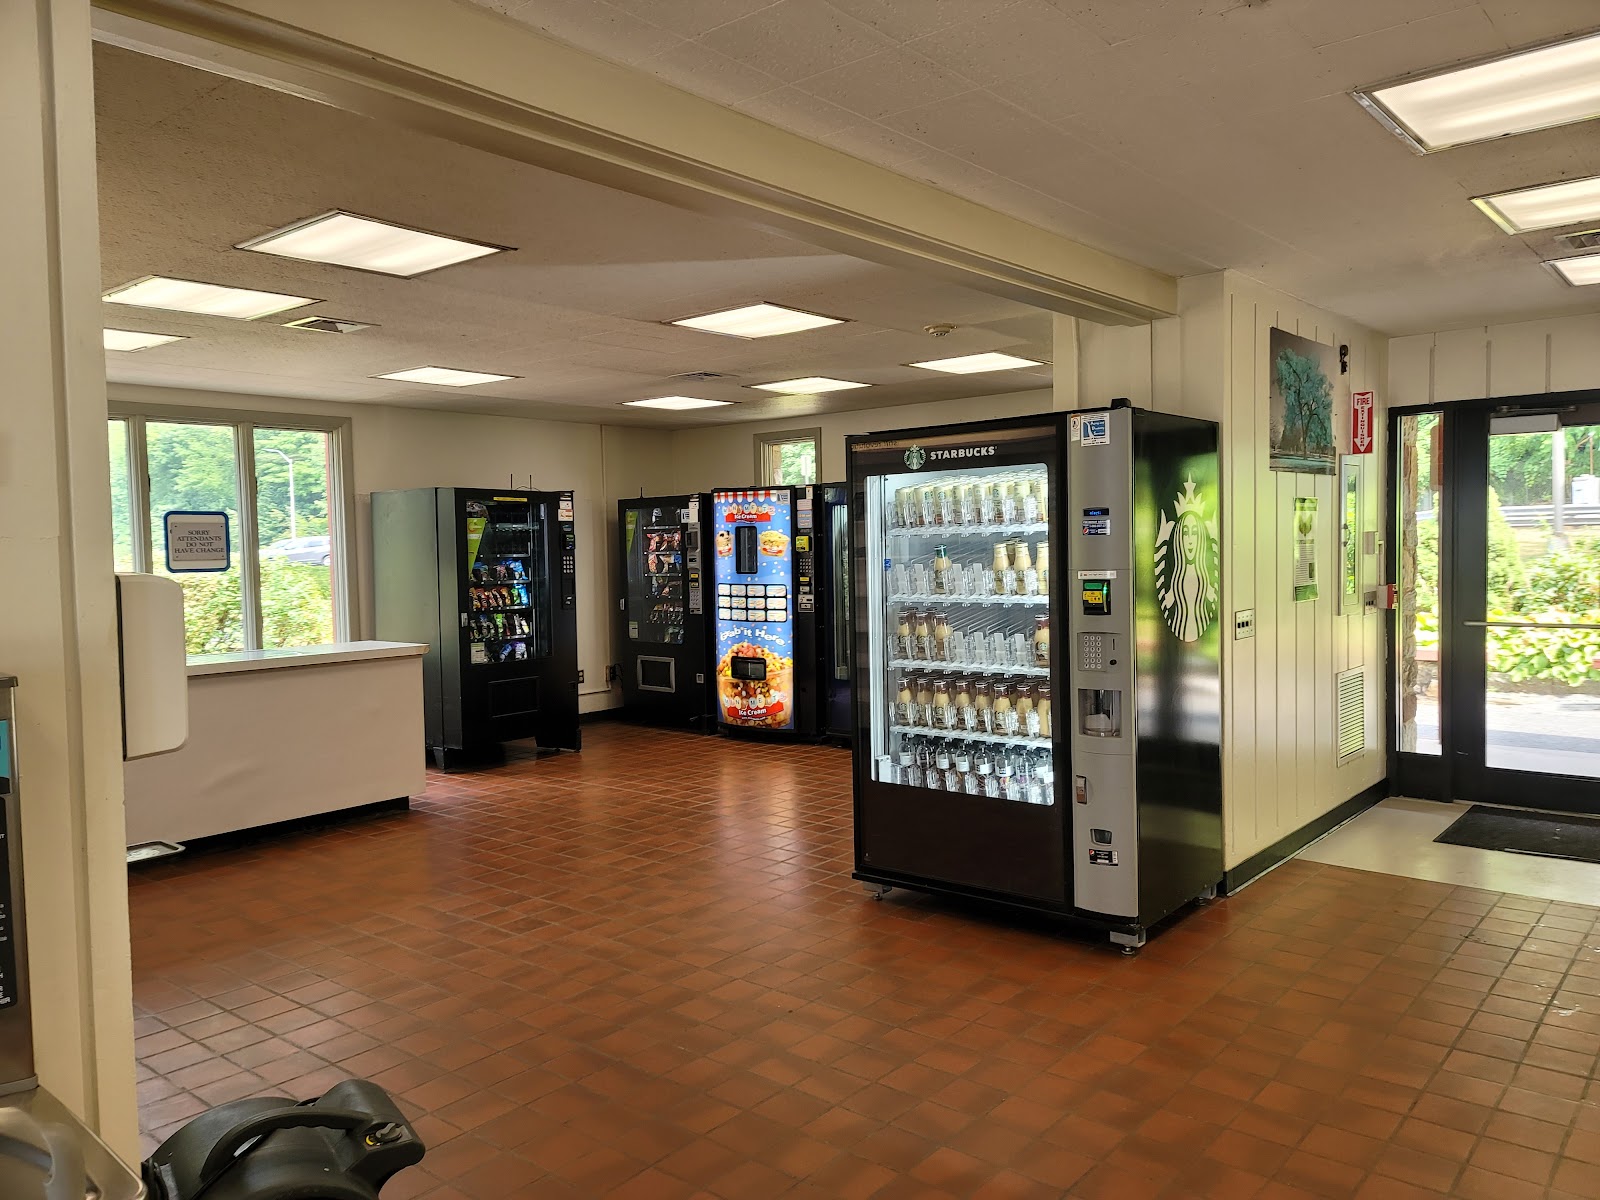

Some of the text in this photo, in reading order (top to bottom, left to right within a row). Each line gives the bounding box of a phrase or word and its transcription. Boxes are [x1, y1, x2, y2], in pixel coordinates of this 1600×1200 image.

[1357, 397, 1370, 405] FIRE
[930, 446, 995, 460] STARBUCKS
[720, 627, 785, 646] Grab it Here
